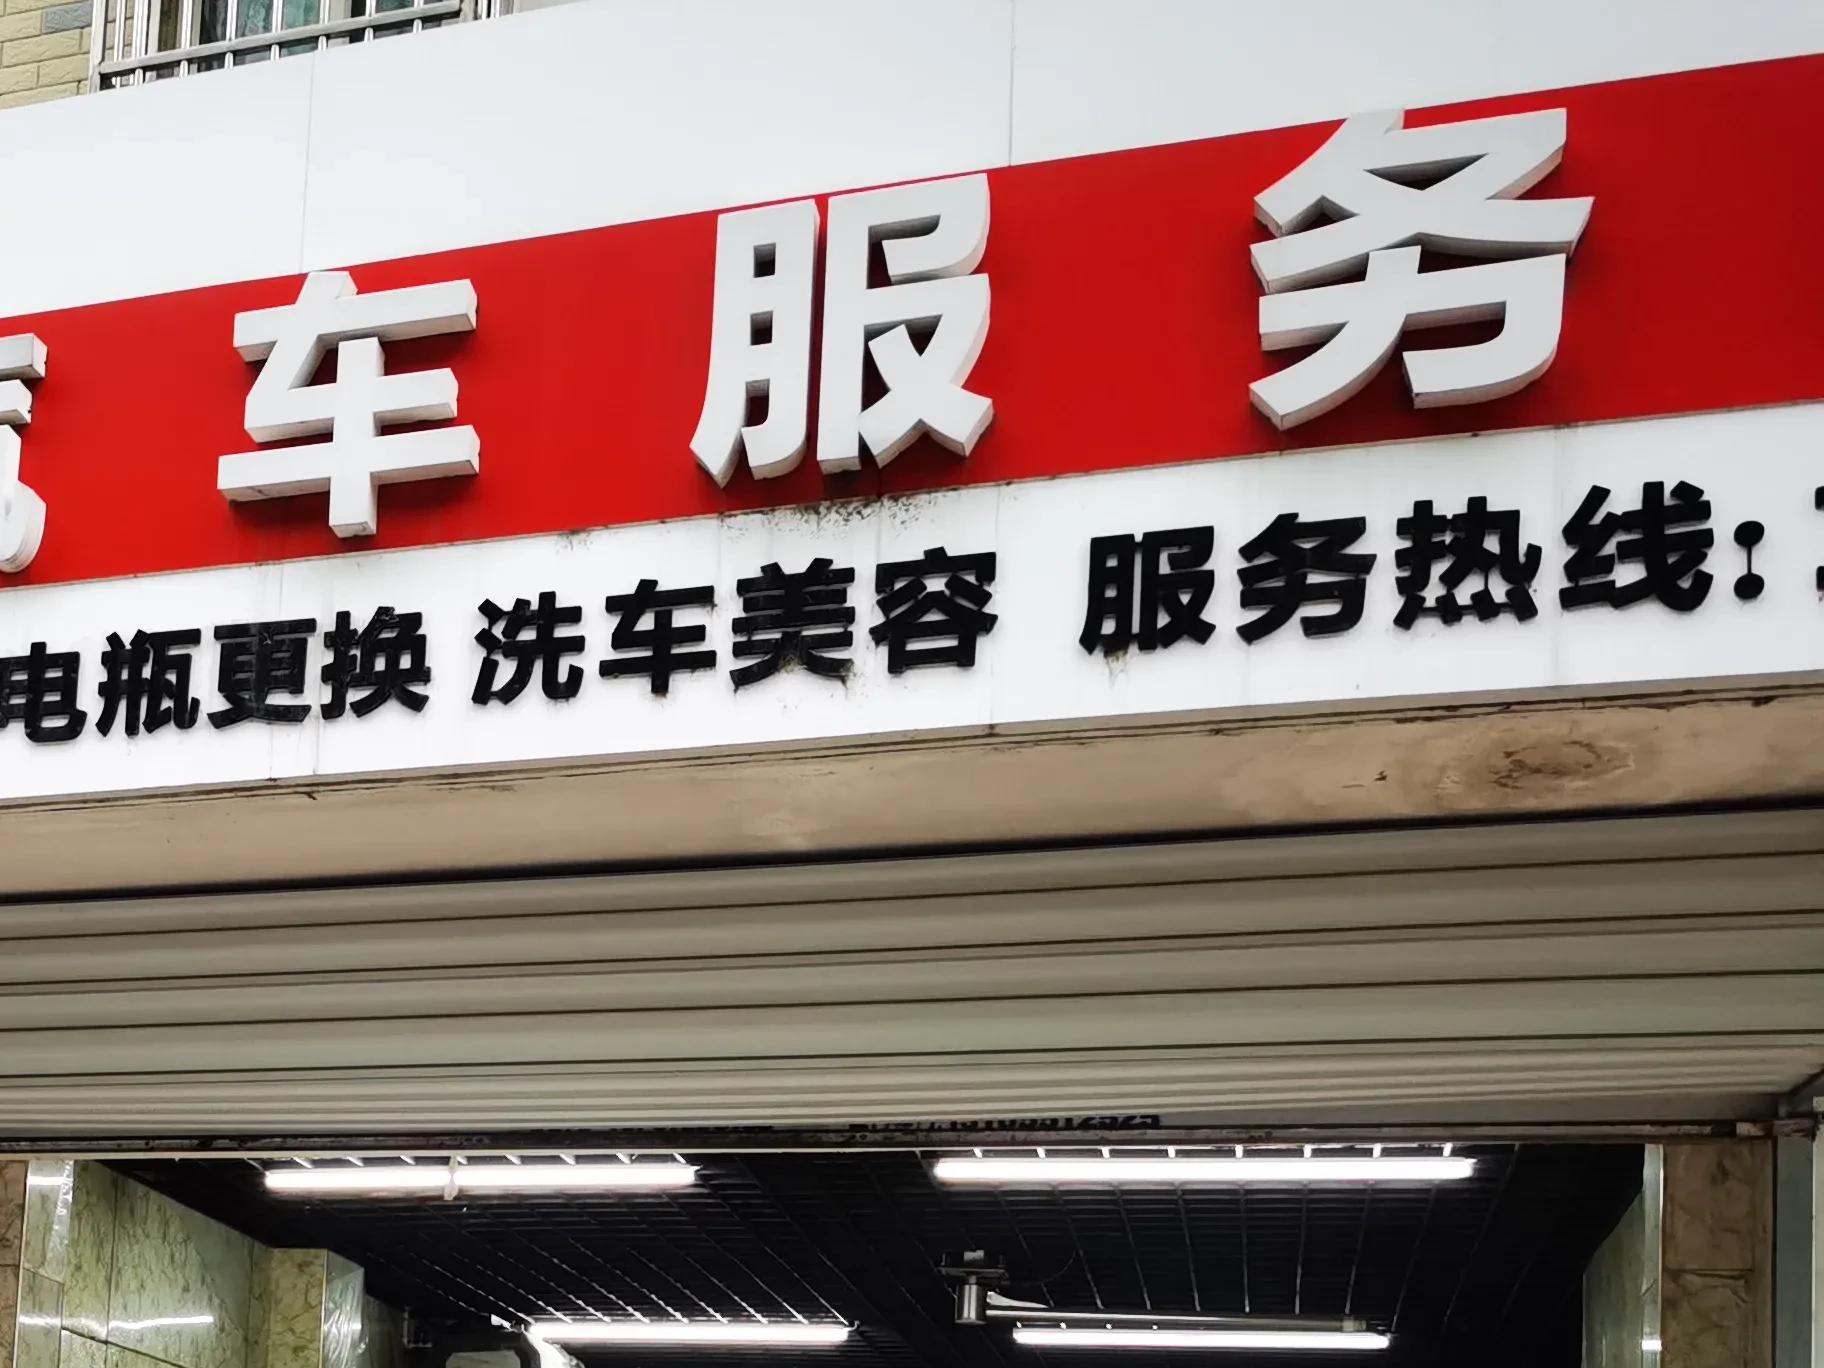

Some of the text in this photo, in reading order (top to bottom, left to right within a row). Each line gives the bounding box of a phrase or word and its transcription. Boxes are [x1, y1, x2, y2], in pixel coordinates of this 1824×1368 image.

[471, 546, 999, 705] 洗车美容
[1079, 481, 1765, 656] 服务热线:
